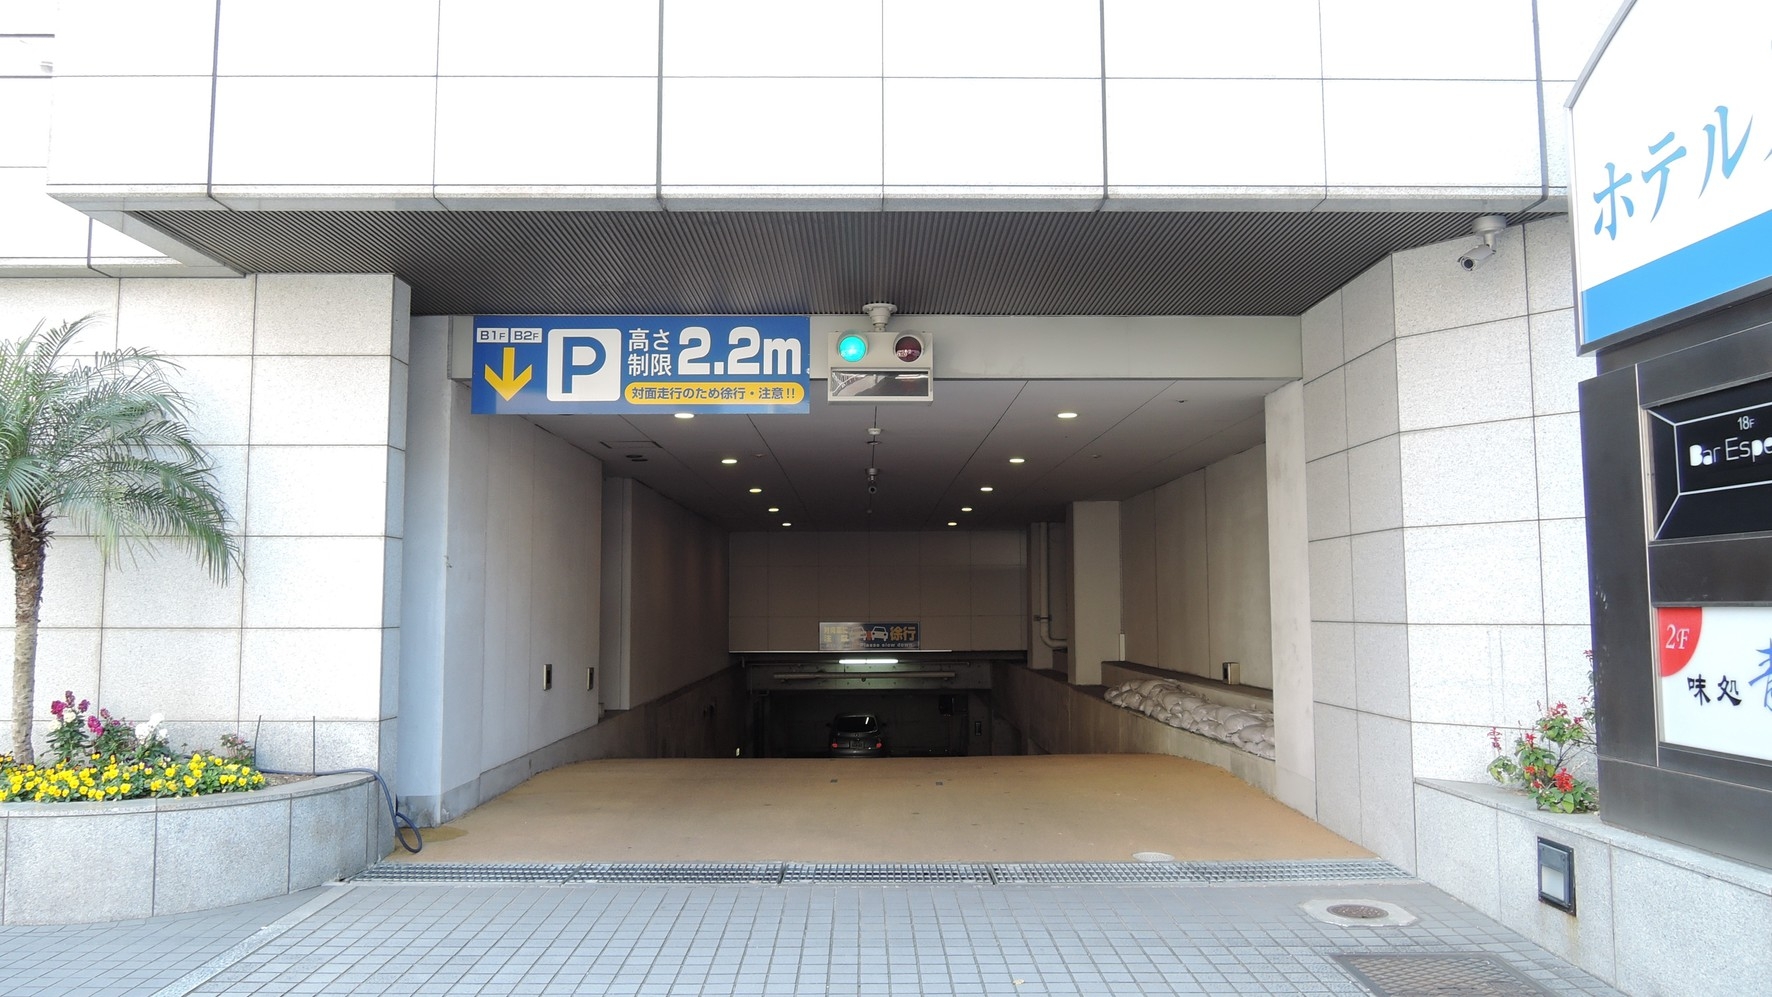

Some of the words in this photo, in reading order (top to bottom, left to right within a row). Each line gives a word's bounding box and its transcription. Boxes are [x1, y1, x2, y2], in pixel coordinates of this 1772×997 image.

[1593, 105, 1772, 241] ホテル
[480, 330, 506, 340] B1F
[514, 330, 539, 340] B2F
[628, 328, 670, 352] 高さ
[677, 326, 802, 375] 2.2m
[561, 336, 607, 394] P
[627, 353, 672, 376] 制限
[632, 387, 795, 400] 対面走行のため徐行・注意!!
[1737, 415, 1755, 430] 18F
[1689, 444, 1721, 467] Bar
[889, 626, 916, 641] 徐行
[1665, 624, 1690, 650] 2F
[1687, 673, 1742, 706] 味処
